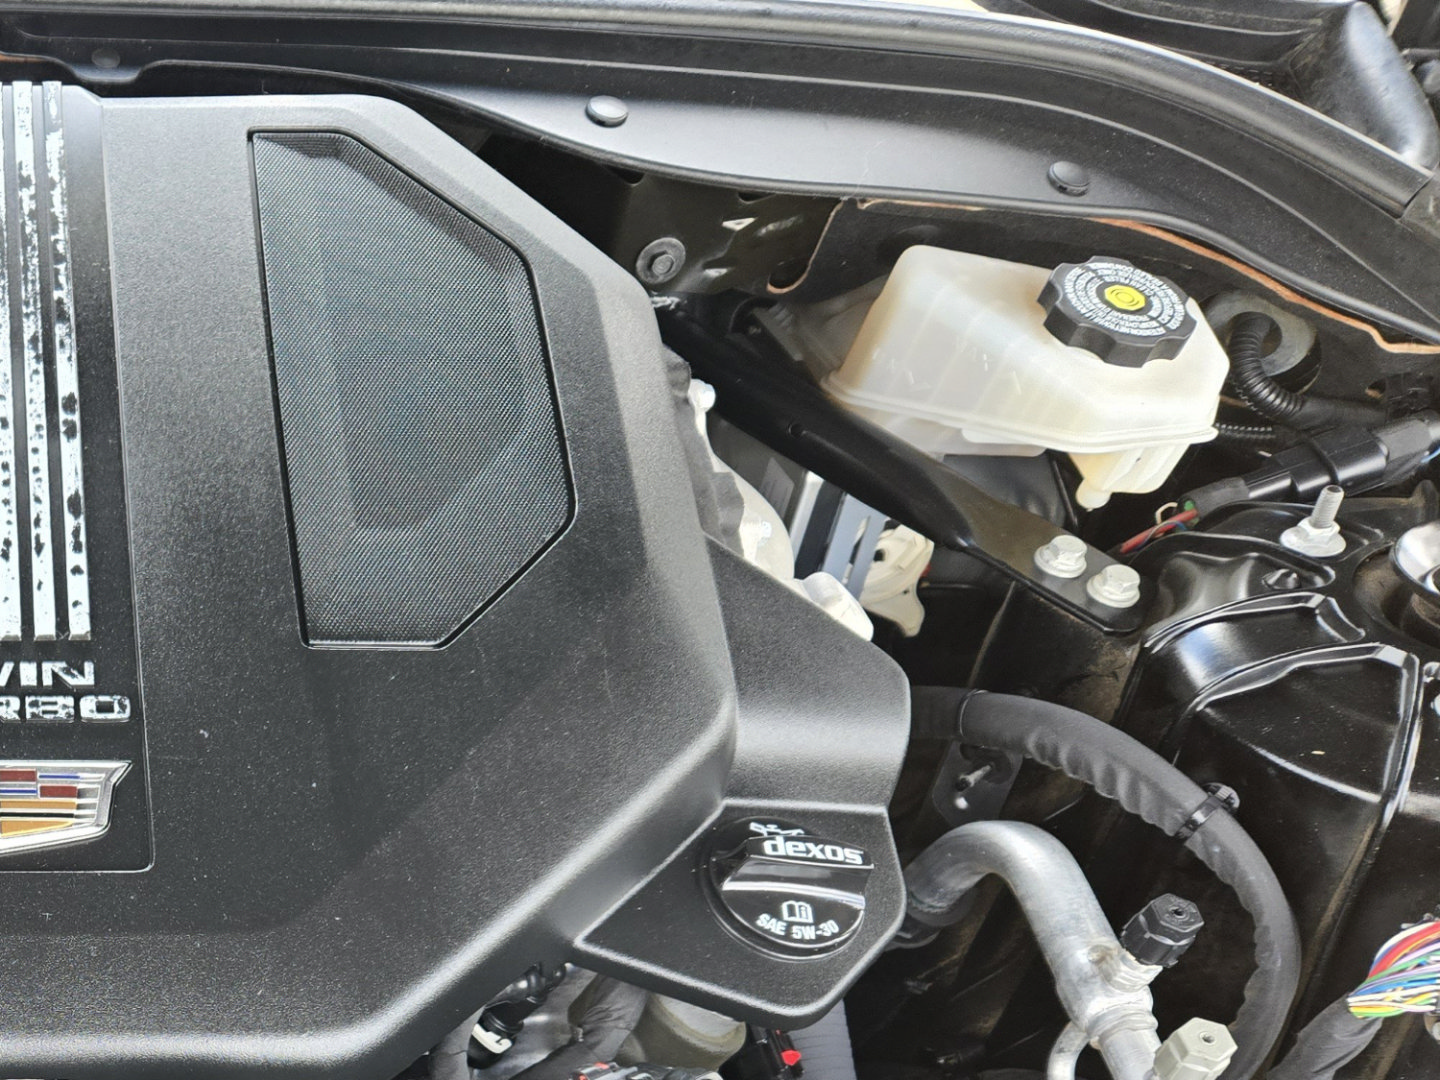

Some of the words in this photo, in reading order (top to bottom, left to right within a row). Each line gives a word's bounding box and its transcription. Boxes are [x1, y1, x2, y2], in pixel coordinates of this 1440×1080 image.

[762, 835, 864, 865] dexos
[755, 913, 787, 936] SAE
[791, 919, 840, 940] 5W-30
